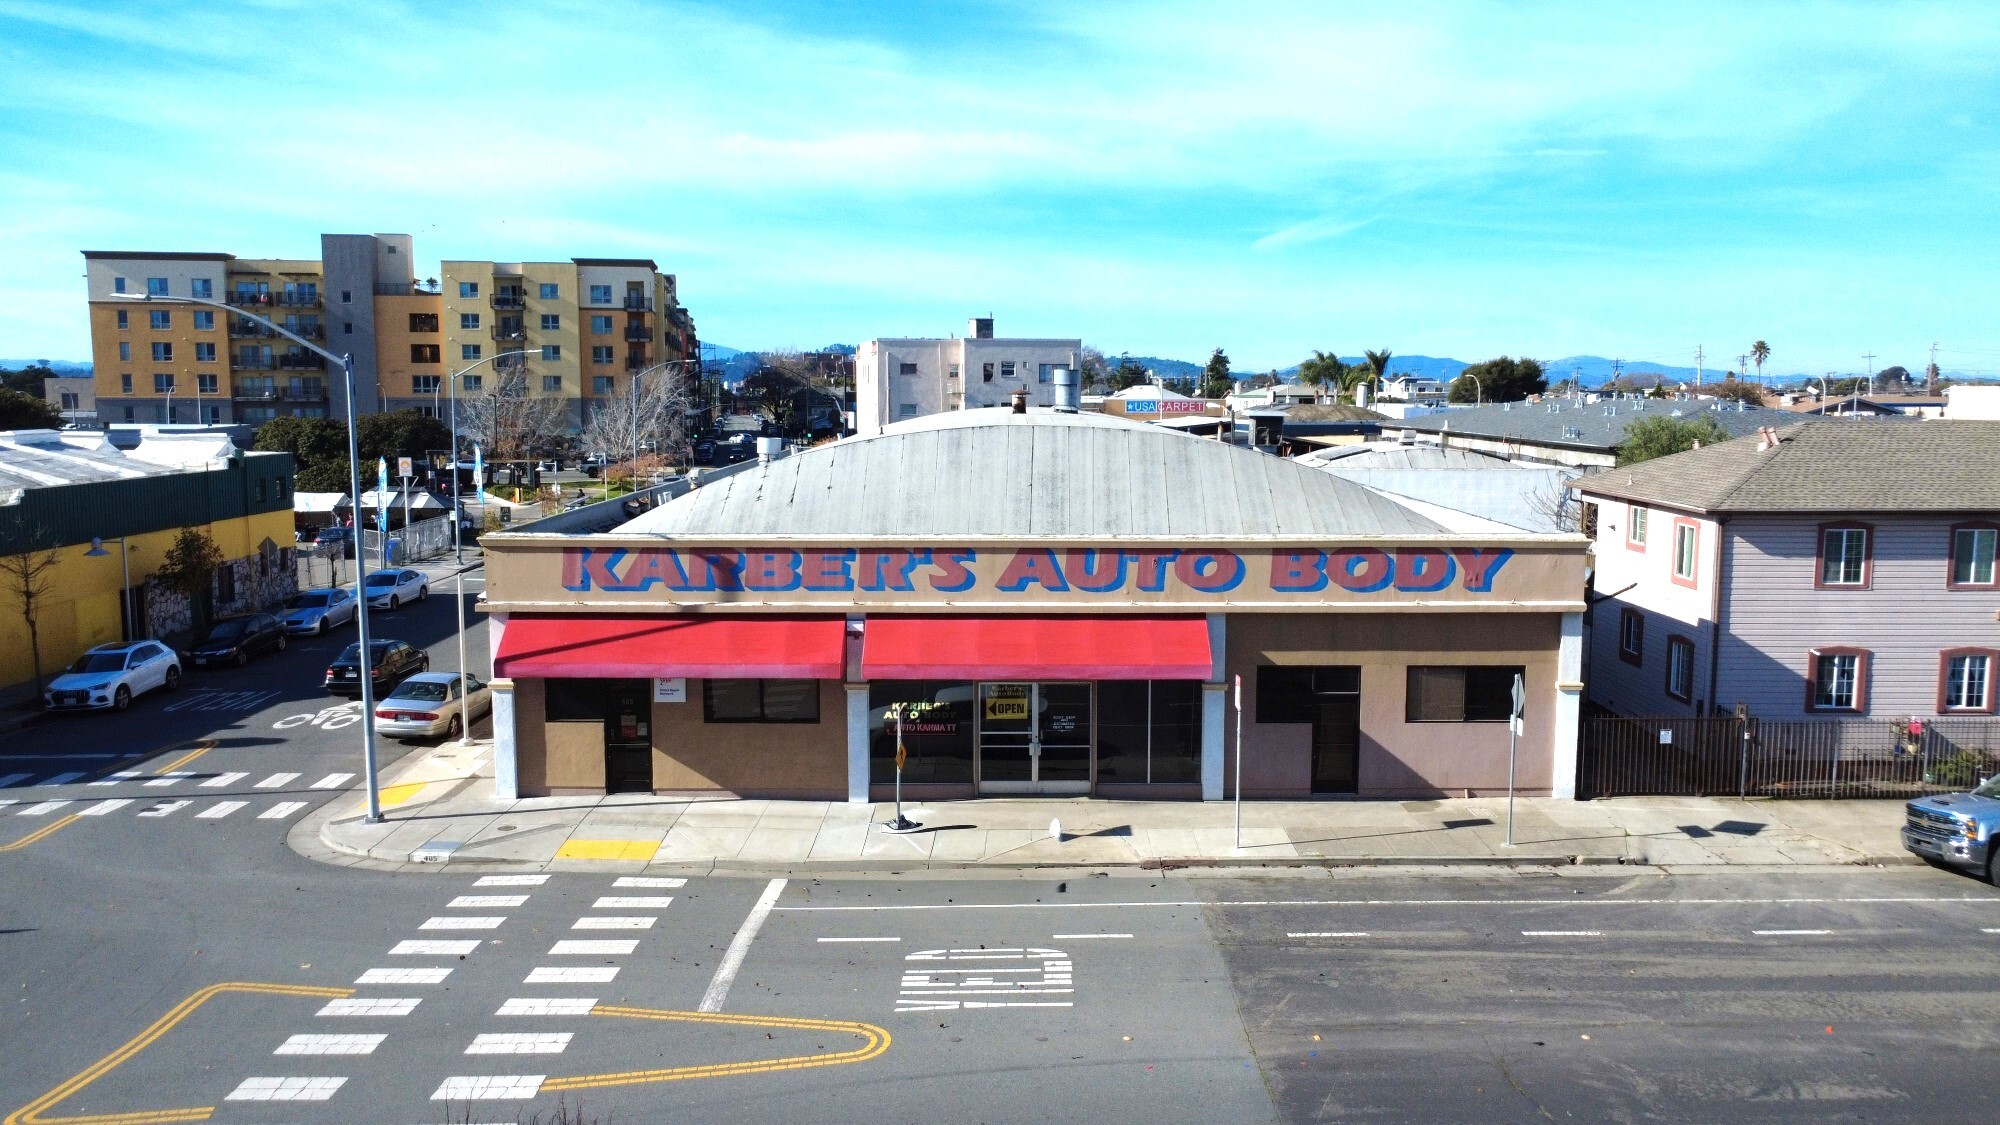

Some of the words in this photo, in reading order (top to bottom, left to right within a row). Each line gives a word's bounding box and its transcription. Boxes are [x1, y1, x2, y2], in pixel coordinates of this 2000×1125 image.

[1134, 402, 1155, 411] USA
[1157, 402, 1202, 411] CARPET
[561, 547, 976, 592] KARBER'S
[994, 547, 1246, 593] AUTO
[1269, 547, 1512, 593] BODY
[998, 703, 1025, 714] OPEN
[917, 723, 945, 732] KARMA
